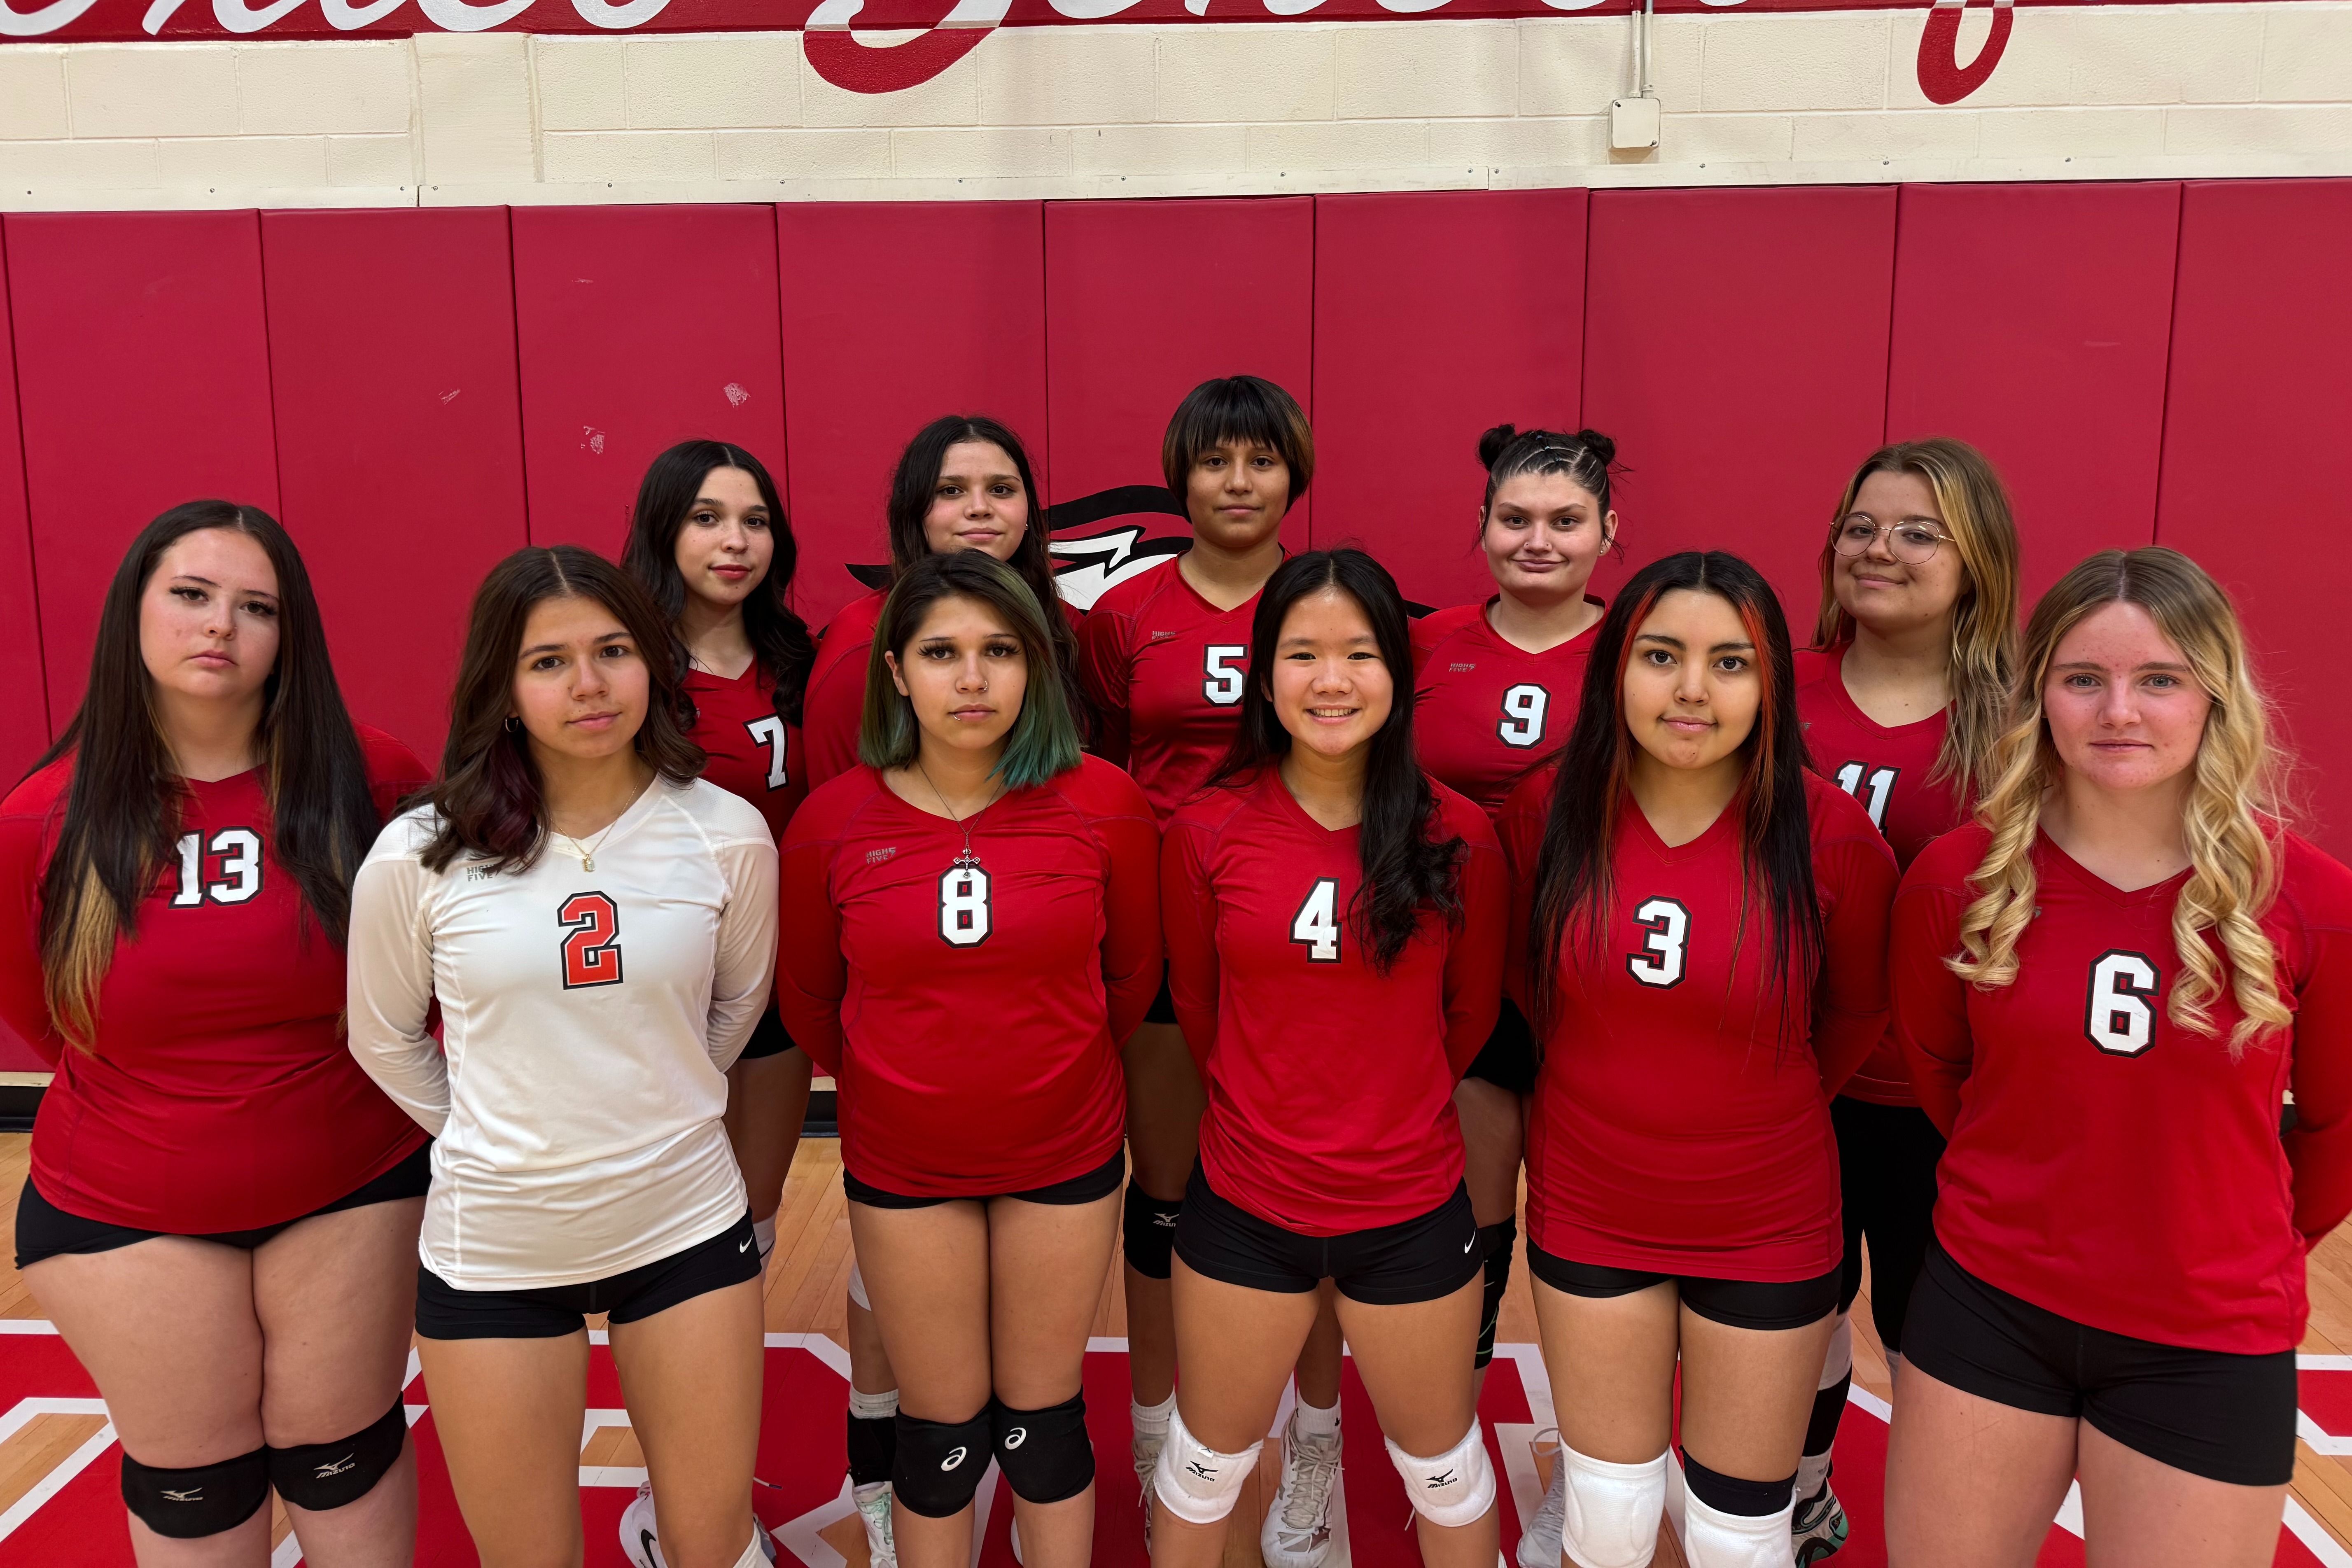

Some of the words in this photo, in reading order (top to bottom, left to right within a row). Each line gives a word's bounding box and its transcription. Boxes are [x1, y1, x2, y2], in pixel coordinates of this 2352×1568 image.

[1202, 644, 1248, 707] 5
[1496, 682, 1551, 750] 9
[742, 713, 789, 792] 7
[168, 826, 264, 909] 13
[866, 854, 888, 865] FIVE
[557, 890, 623, 990] 2
[937, 864, 993, 949] 8
[1289, 876, 1342, 964] 4
[1626, 895, 1692, 989] 3
[2084, 948, 2161, 1059] 6
